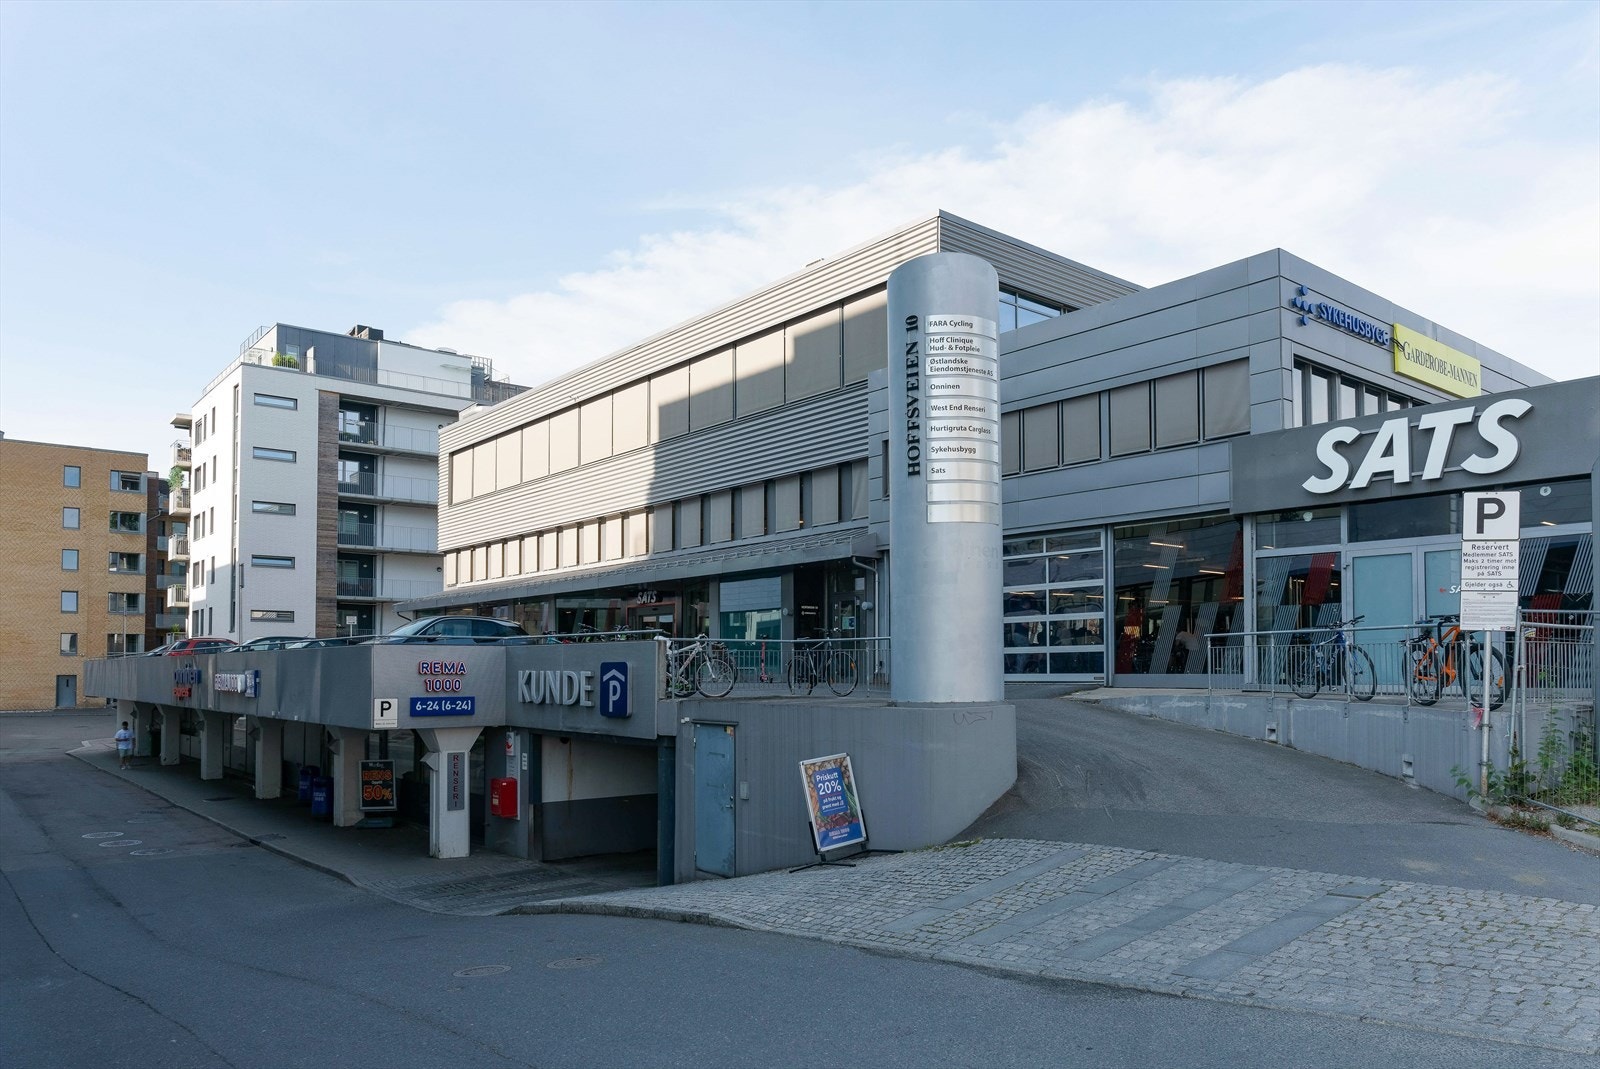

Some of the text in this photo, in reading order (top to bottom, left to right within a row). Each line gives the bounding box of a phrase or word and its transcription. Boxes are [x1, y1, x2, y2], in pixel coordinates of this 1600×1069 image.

[949, 320, 973, 328] Cycling
[1319, 302, 1390, 346] SYKEHUSBYGG
[955, 345, 981, 353] Fotpleie
[929, 366, 987, 375] Eiendomstjeneste
[905, 315, 920, 477] HOFFSVEIEN 10
[964, 405, 986, 413] Renseri
[968, 426, 991, 434] Carglass
[930, 446, 977, 454] Sykehusbygg
[1301, 398, 1535, 495] SATS
[1476, 497, 1506, 534] P
[636, 591, 657, 604] SATS
[419, 661, 467, 675] REMA
[425, 678, 461, 692] 1000
[518, 670, 595, 707] KUNDE
[608, 680, 621, 712] P
[380, 701, 392, 717] P
[415, 700, 472, 711] 6-24 (6-24)
[815, 772, 839, 782] Priskutt
[363, 785, 393, 801] 50%
[818, 780, 842, 796] 20%
